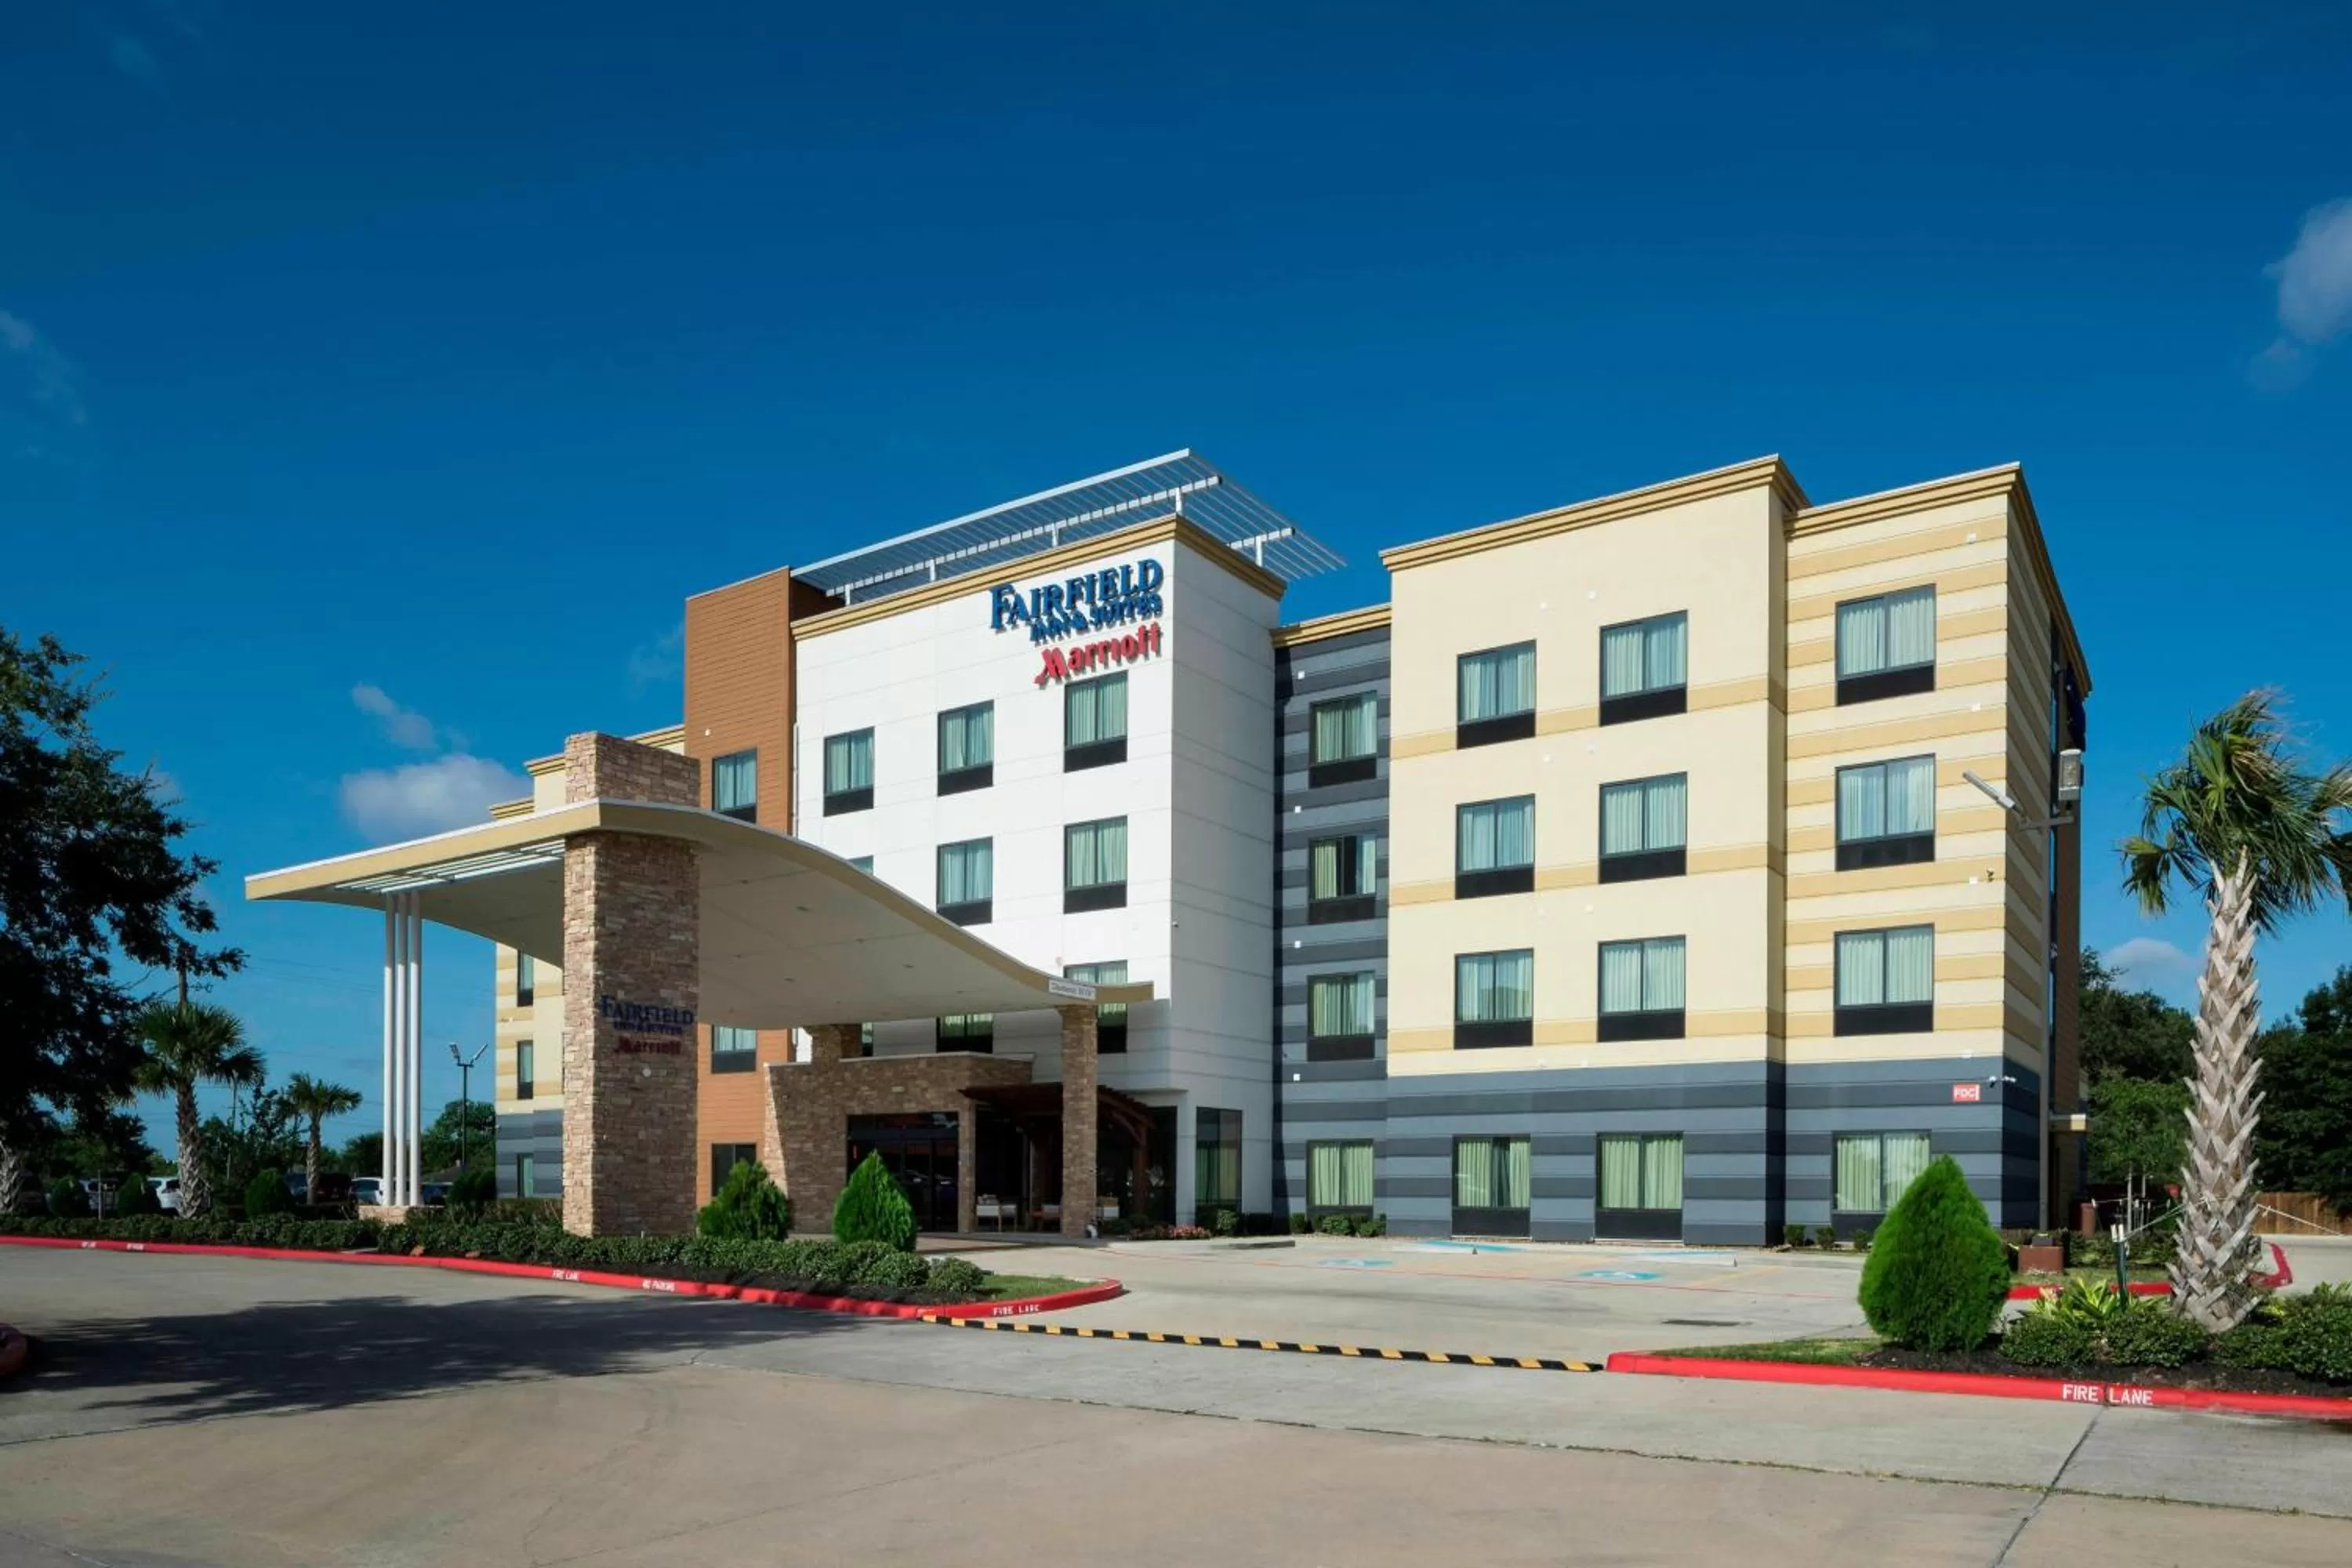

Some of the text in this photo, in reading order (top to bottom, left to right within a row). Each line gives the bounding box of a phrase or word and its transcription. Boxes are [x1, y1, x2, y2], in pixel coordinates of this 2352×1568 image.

[989, 557, 1164, 630] FAIRFIELD
[1034, 622, 1163, 686] Marriott
[601, 993, 695, 1026] FAIRFIELD
[2062, 1383, 2154, 1406] FIRE LANE
